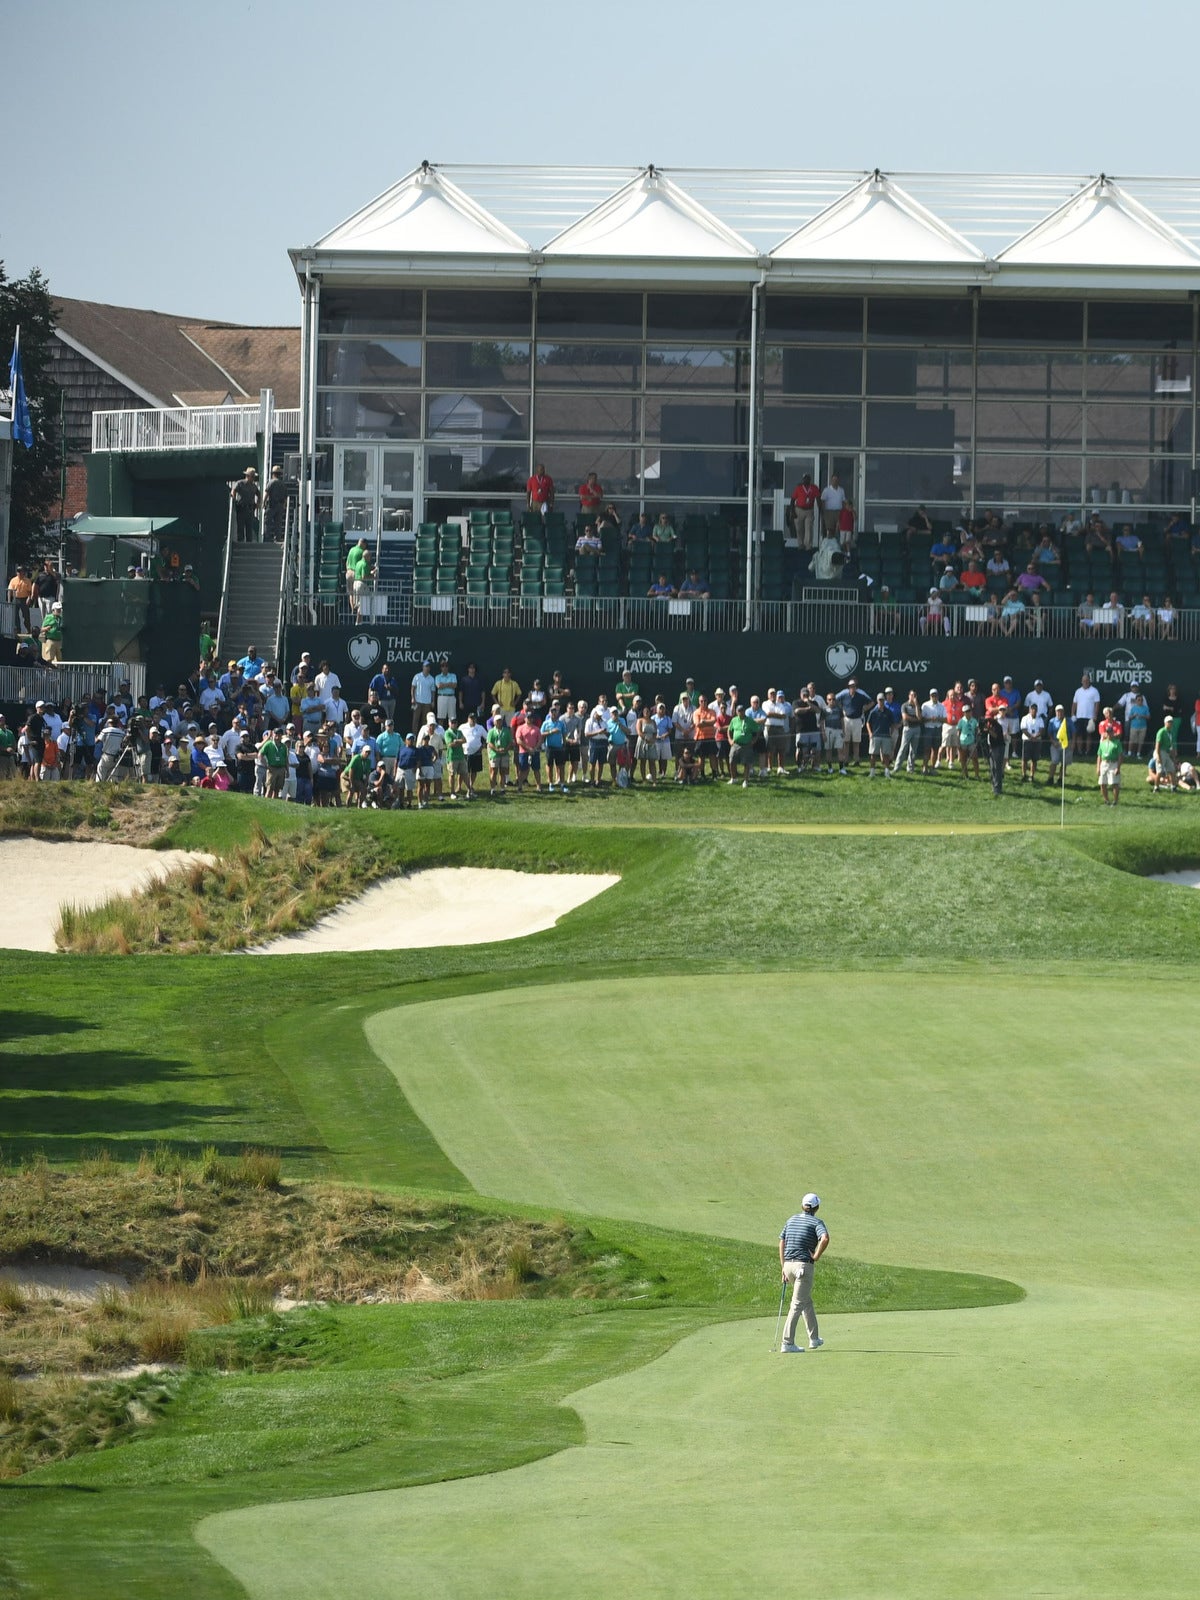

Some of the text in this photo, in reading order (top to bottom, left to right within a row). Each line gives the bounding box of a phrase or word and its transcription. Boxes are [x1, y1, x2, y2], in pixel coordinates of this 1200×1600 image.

[386, 636, 411, 649] THE
[386, 650, 449, 663] BARCLAYS
[864, 645, 888, 658] THE
[616, 659, 673, 674] PLAYOFFS
[864, 659, 928, 672] BARCLAYS
[1096, 670, 1153, 683] PLAYOFFS
